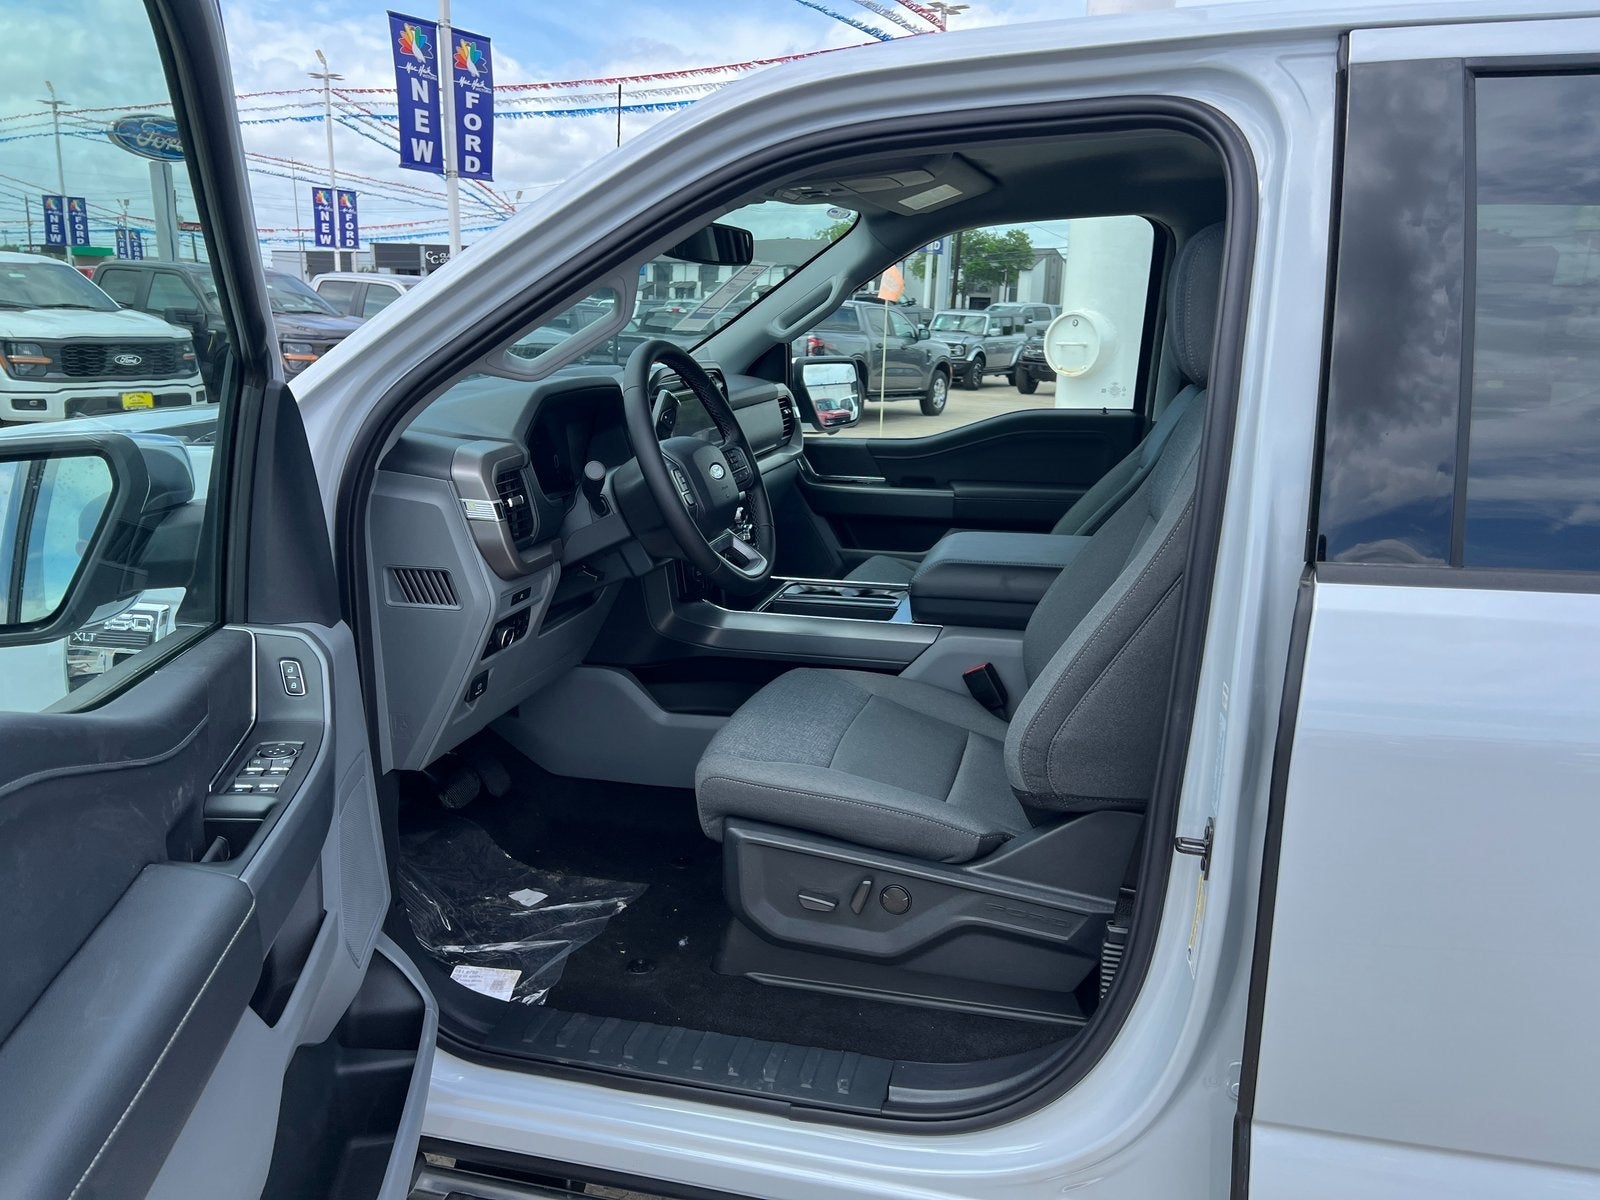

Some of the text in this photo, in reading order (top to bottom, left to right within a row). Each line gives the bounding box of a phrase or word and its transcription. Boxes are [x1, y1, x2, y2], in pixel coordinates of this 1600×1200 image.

[410, 77, 434, 164] NEW
[463, 91, 483, 173] FORD
[49, 215, 62, 243] NEW
[75, 217, 84, 244] FORD
[320, 211, 331, 245] NEW
[345, 214, 354, 246] FORD
[73, 632, 97, 642] XLT
